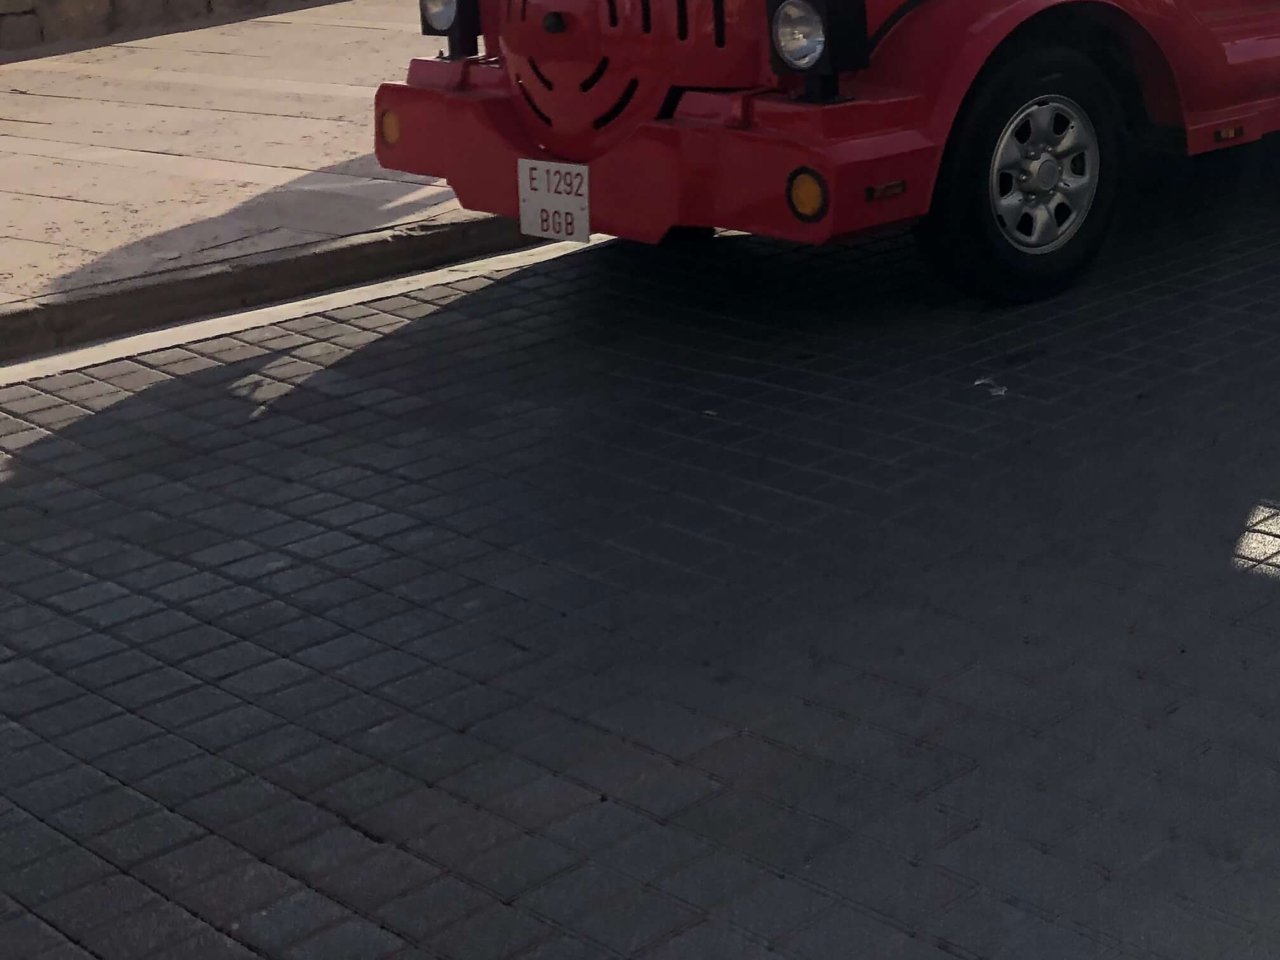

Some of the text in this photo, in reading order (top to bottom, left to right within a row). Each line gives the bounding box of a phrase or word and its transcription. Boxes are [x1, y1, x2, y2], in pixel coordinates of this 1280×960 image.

[529, 166, 584, 197] E 1292
[540, 208, 575, 236] BGB
